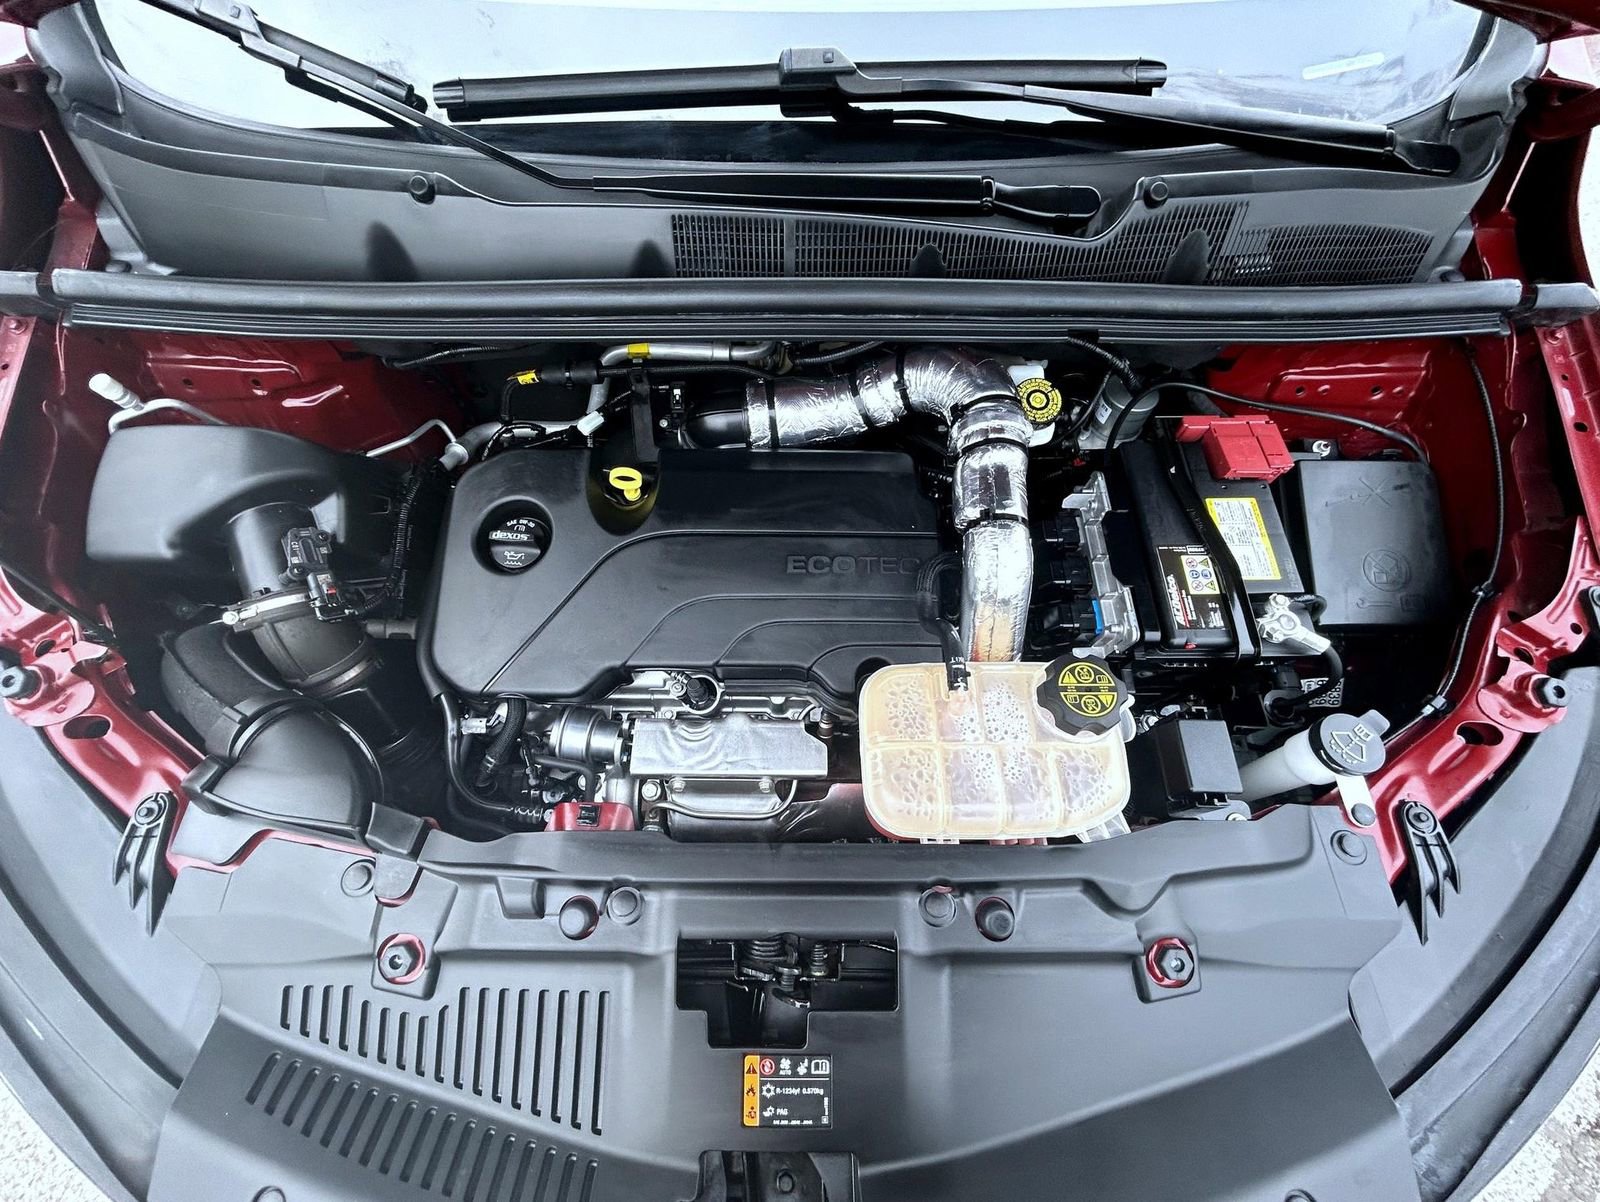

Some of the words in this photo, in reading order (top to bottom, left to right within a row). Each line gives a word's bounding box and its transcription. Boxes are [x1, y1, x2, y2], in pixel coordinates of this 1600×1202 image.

[492, 530, 530, 541] dexos
[786, 555, 920, 574] ECOTEC
[776, 1108, 789, 1116] PAG
